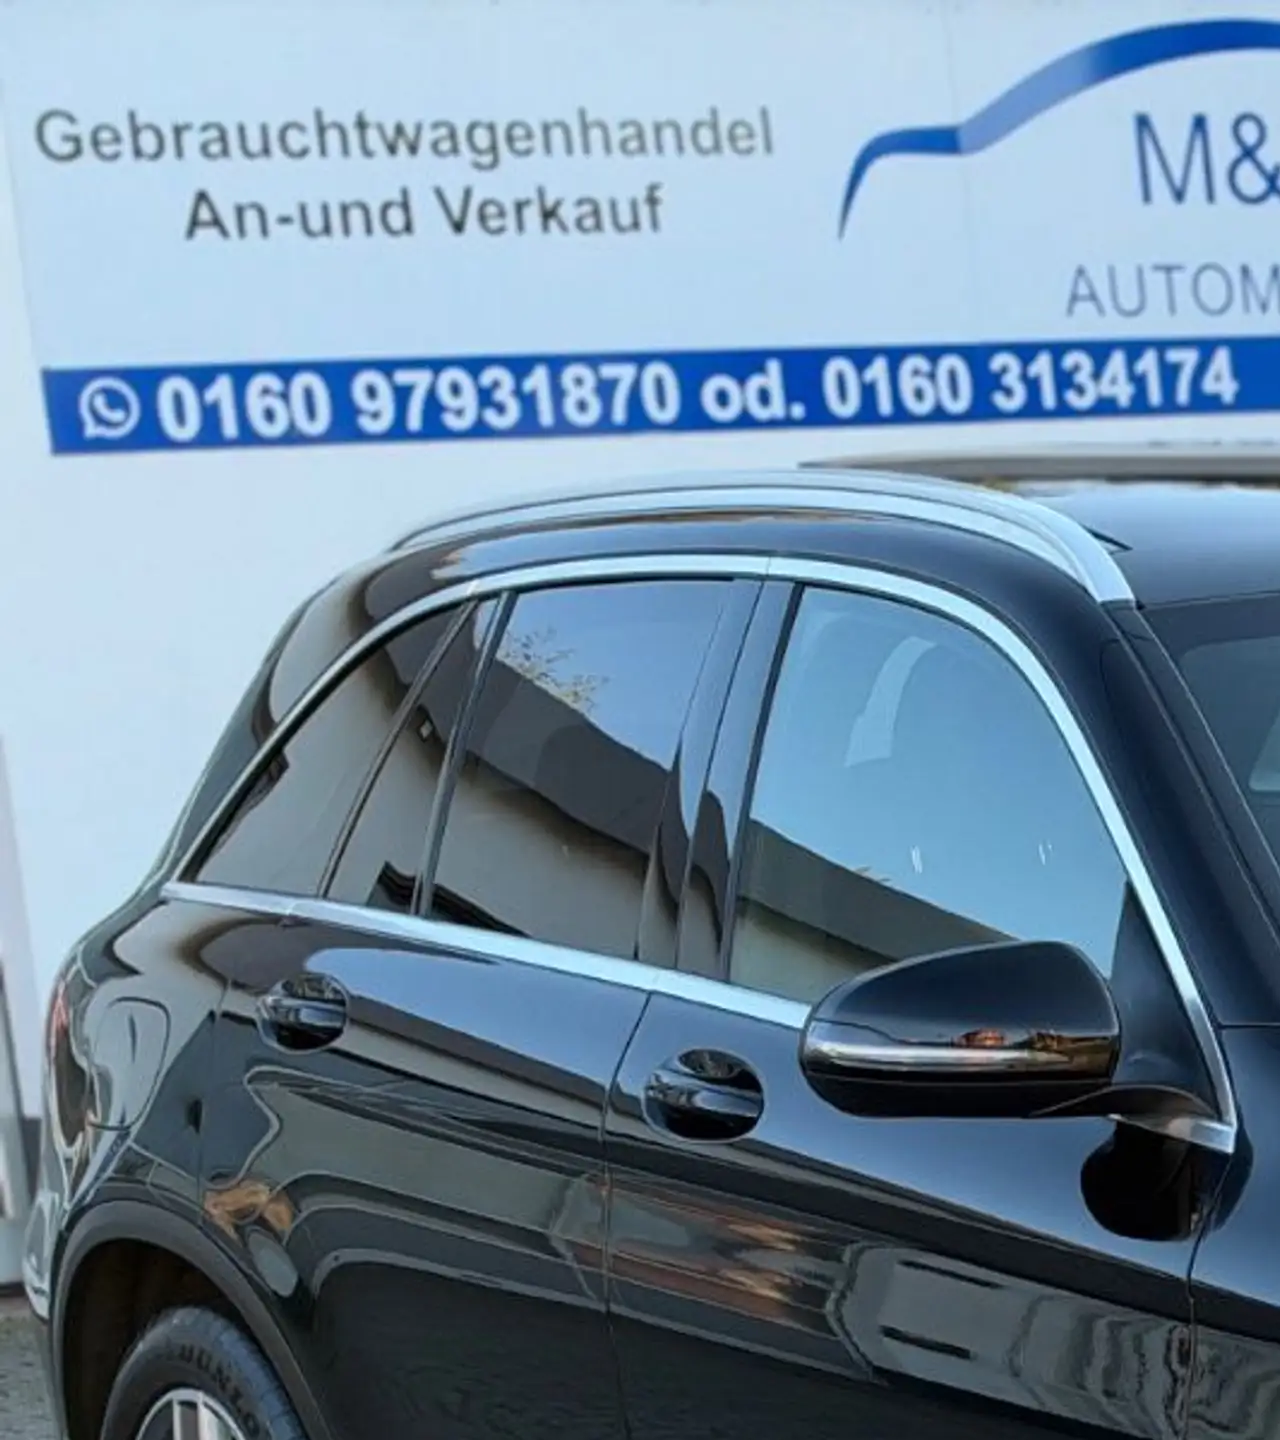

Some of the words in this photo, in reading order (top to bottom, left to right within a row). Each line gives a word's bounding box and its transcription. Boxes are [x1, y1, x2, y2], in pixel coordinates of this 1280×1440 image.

[35, 107, 773, 171] Gebrauchtwagenhandel
[185, 187, 414, 241] An-und
[433, 183, 662, 236] Verkauf
[157, 373, 332, 443] 0160
[350, 361, 681, 434] 97931870
[700, 360, 805, 421] od.
[823, 354, 972, 417] 0160
[989, 348, 1239, 412] 3134174
